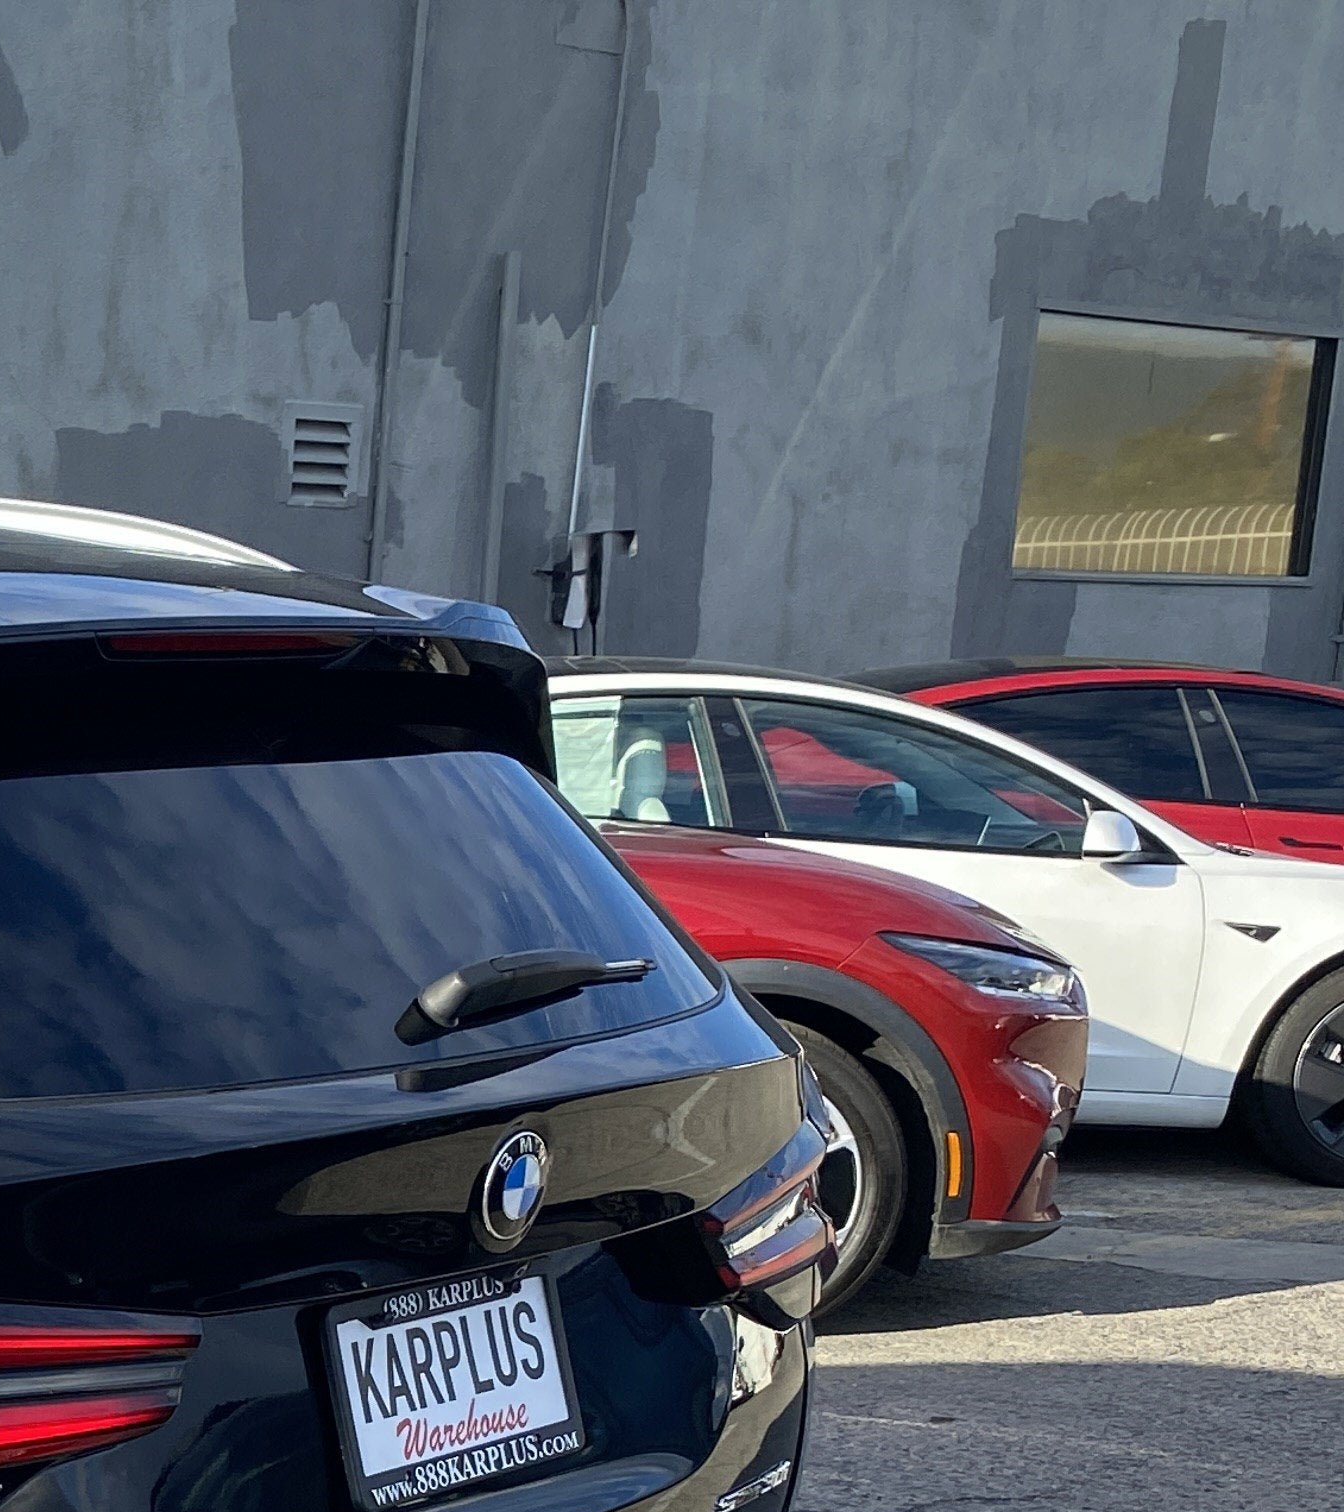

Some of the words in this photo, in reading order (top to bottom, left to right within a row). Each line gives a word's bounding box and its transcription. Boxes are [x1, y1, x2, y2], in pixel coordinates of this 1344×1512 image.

[498, 1135, 547, 1172] BMW
[382, 1293, 424, 1322] (888)
[427, 1275, 505, 1310] KARPLUS
[350, 1300, 545, 1424] KARPLUS
[396, 1398, 529, 1461] Warehouse
